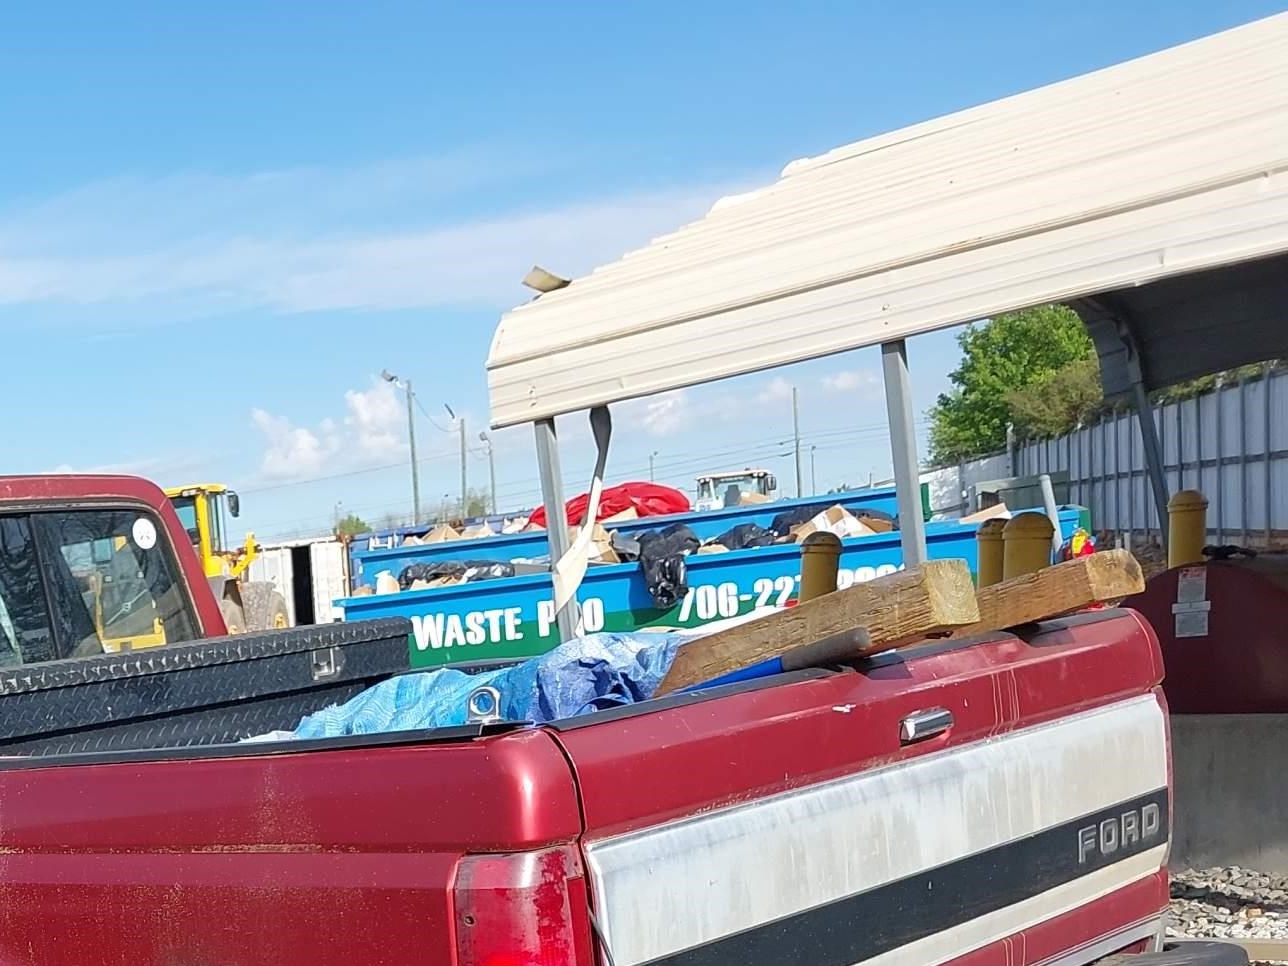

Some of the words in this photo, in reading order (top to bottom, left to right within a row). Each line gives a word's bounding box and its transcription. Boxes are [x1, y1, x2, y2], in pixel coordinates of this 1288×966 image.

[411, 607, 524, 651] WASTE
[537, 597, 604, 638] PO
[1078, 803, 1160, 864] FORD
